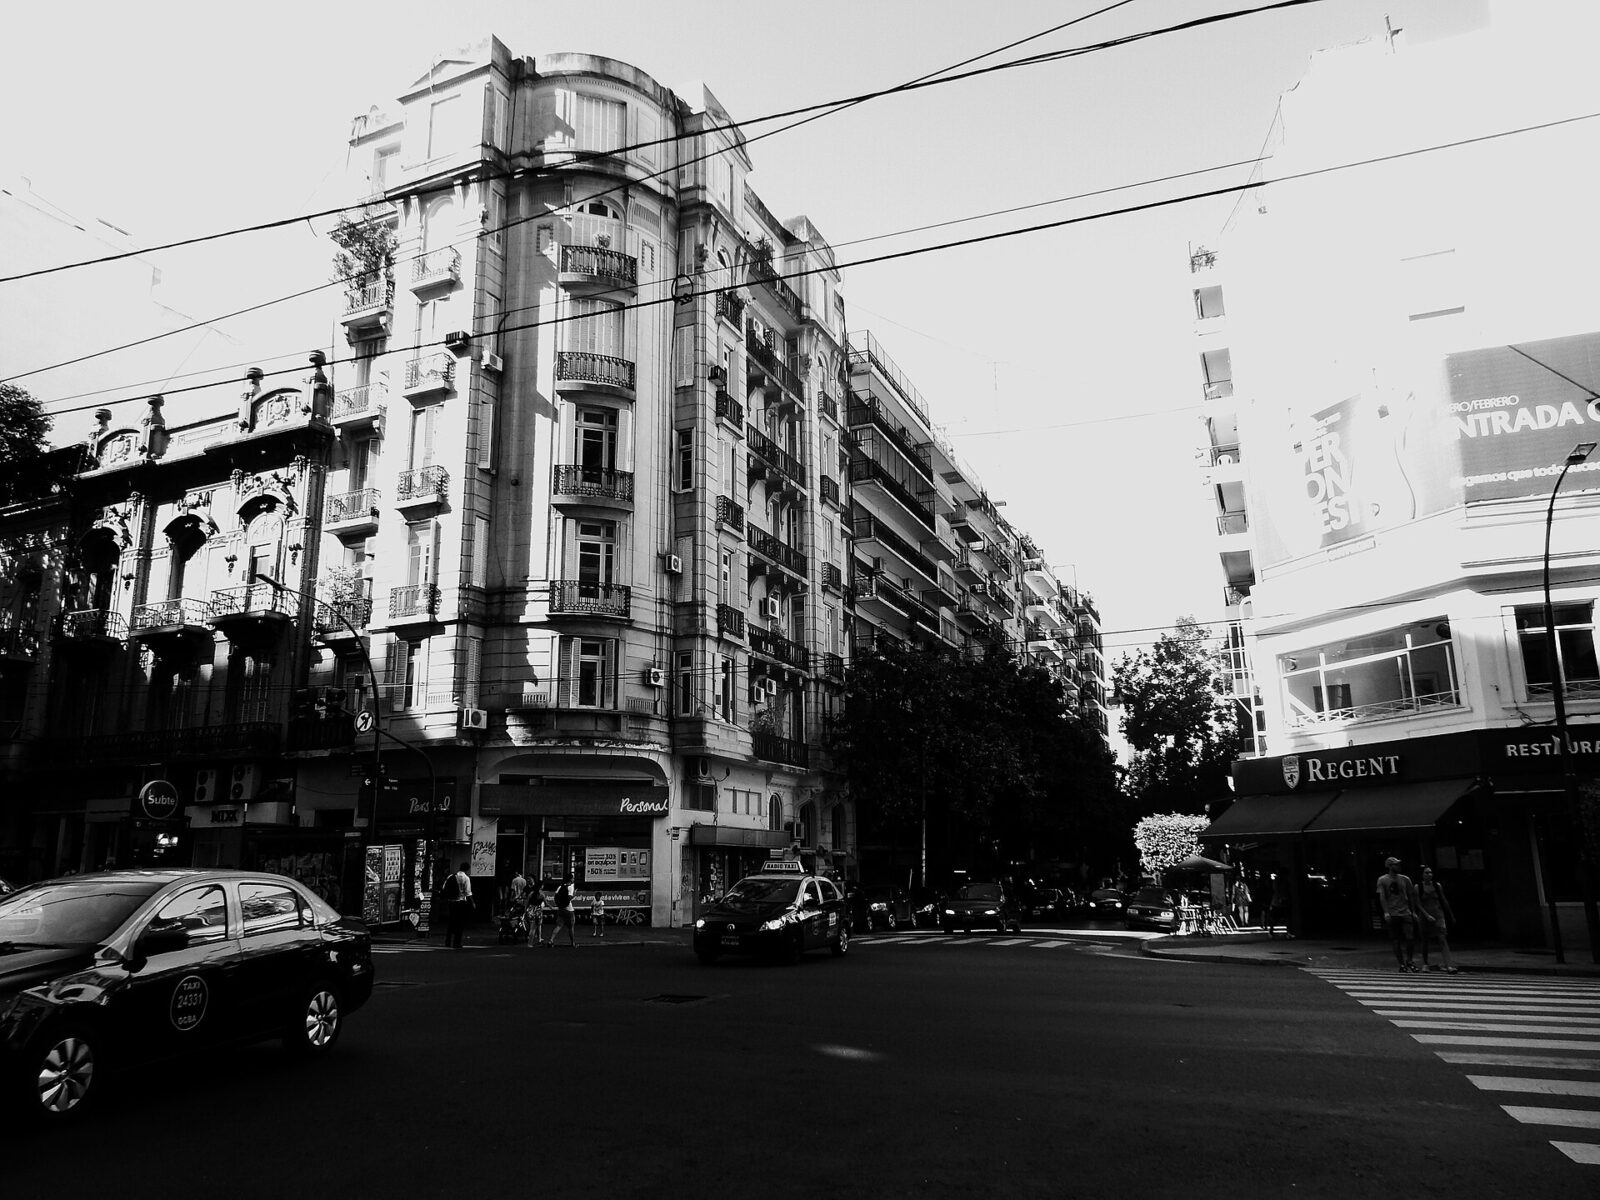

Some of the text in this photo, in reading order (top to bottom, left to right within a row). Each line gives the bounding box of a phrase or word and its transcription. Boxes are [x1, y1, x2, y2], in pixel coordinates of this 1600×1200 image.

[147, 794, 176, 806] Subte
[408, 795, 451, 814] Persal
[619, 797, 669, 813] Personal
[182, 981, 201, 991] TAXI
